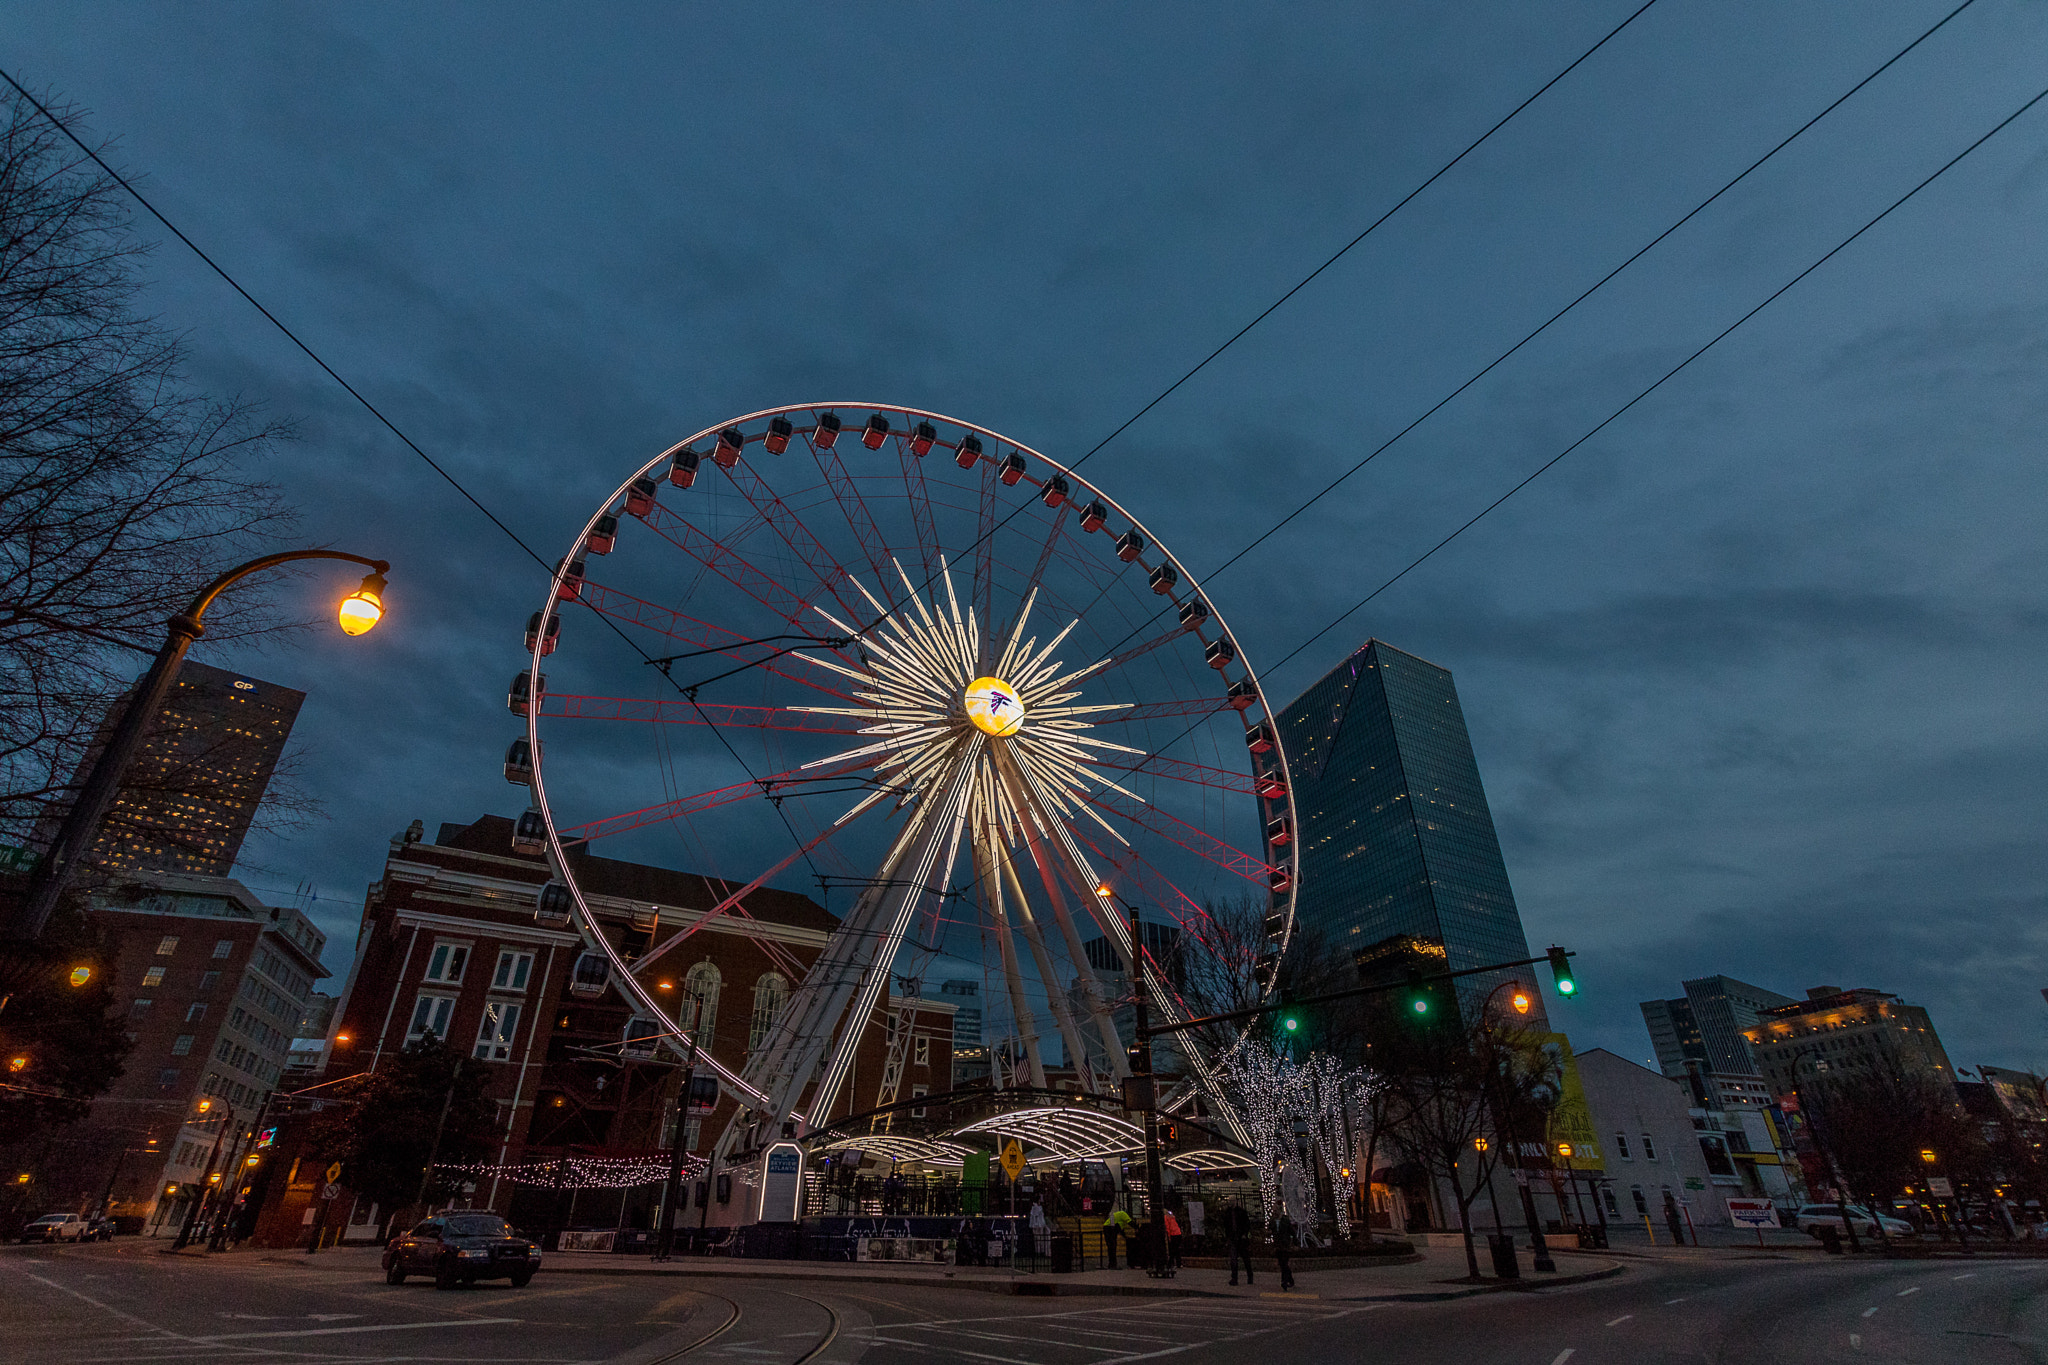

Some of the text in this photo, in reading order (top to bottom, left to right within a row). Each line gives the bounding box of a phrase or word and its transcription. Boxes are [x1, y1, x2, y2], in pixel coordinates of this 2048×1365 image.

[233, 680, 254, 690] GP
[907, 979, 915, 995] 5
[1575, 1144, 1599, 1159] ATL
